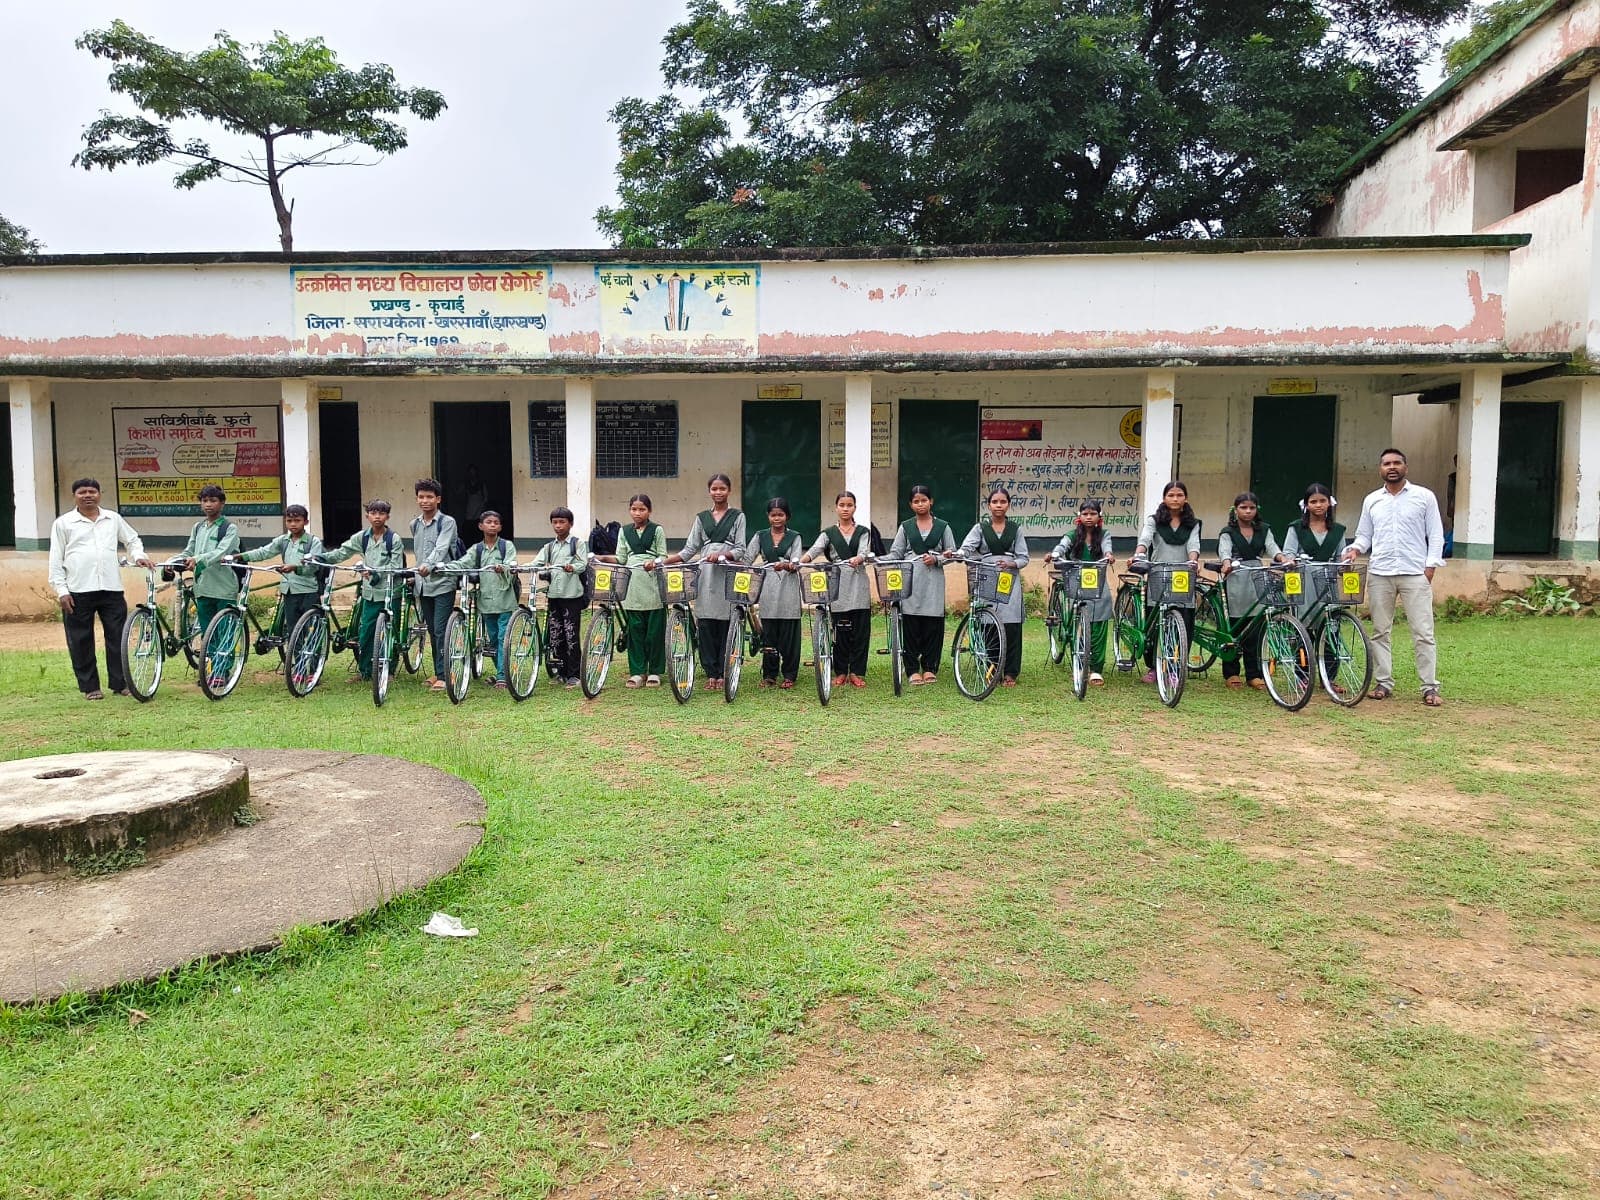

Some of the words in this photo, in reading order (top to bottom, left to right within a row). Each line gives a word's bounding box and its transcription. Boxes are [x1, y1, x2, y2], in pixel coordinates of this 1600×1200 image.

[295, 272, 352, 293] उत्क्रमित
[355, 276, 396, 292] मध्य
[399, 271, 464, 293] विद्यालय
[468, 272, 498, 293] छोटा
[613, 272, 633, 287] चलो
[369, 299, 411, 312] प्रखण्ड
[428, 294, 465, 316] कुचाई
[304, 313, 345, 330] जिला
[353, 312, 426, 330] सरायकेला
[222, 411, 252, 427] फुले
[214, 424, 258, 439] योजना
[983, 447, 994, 460] हर
[996, 444, 1012, 460] रोग
[1025, 448, 1042, 458] अब
[1077, 443, 1095, 459] योग
[982, 461, 1017, 475] दिनचर्या
[1031, 464, 1052, 483] सुबह
